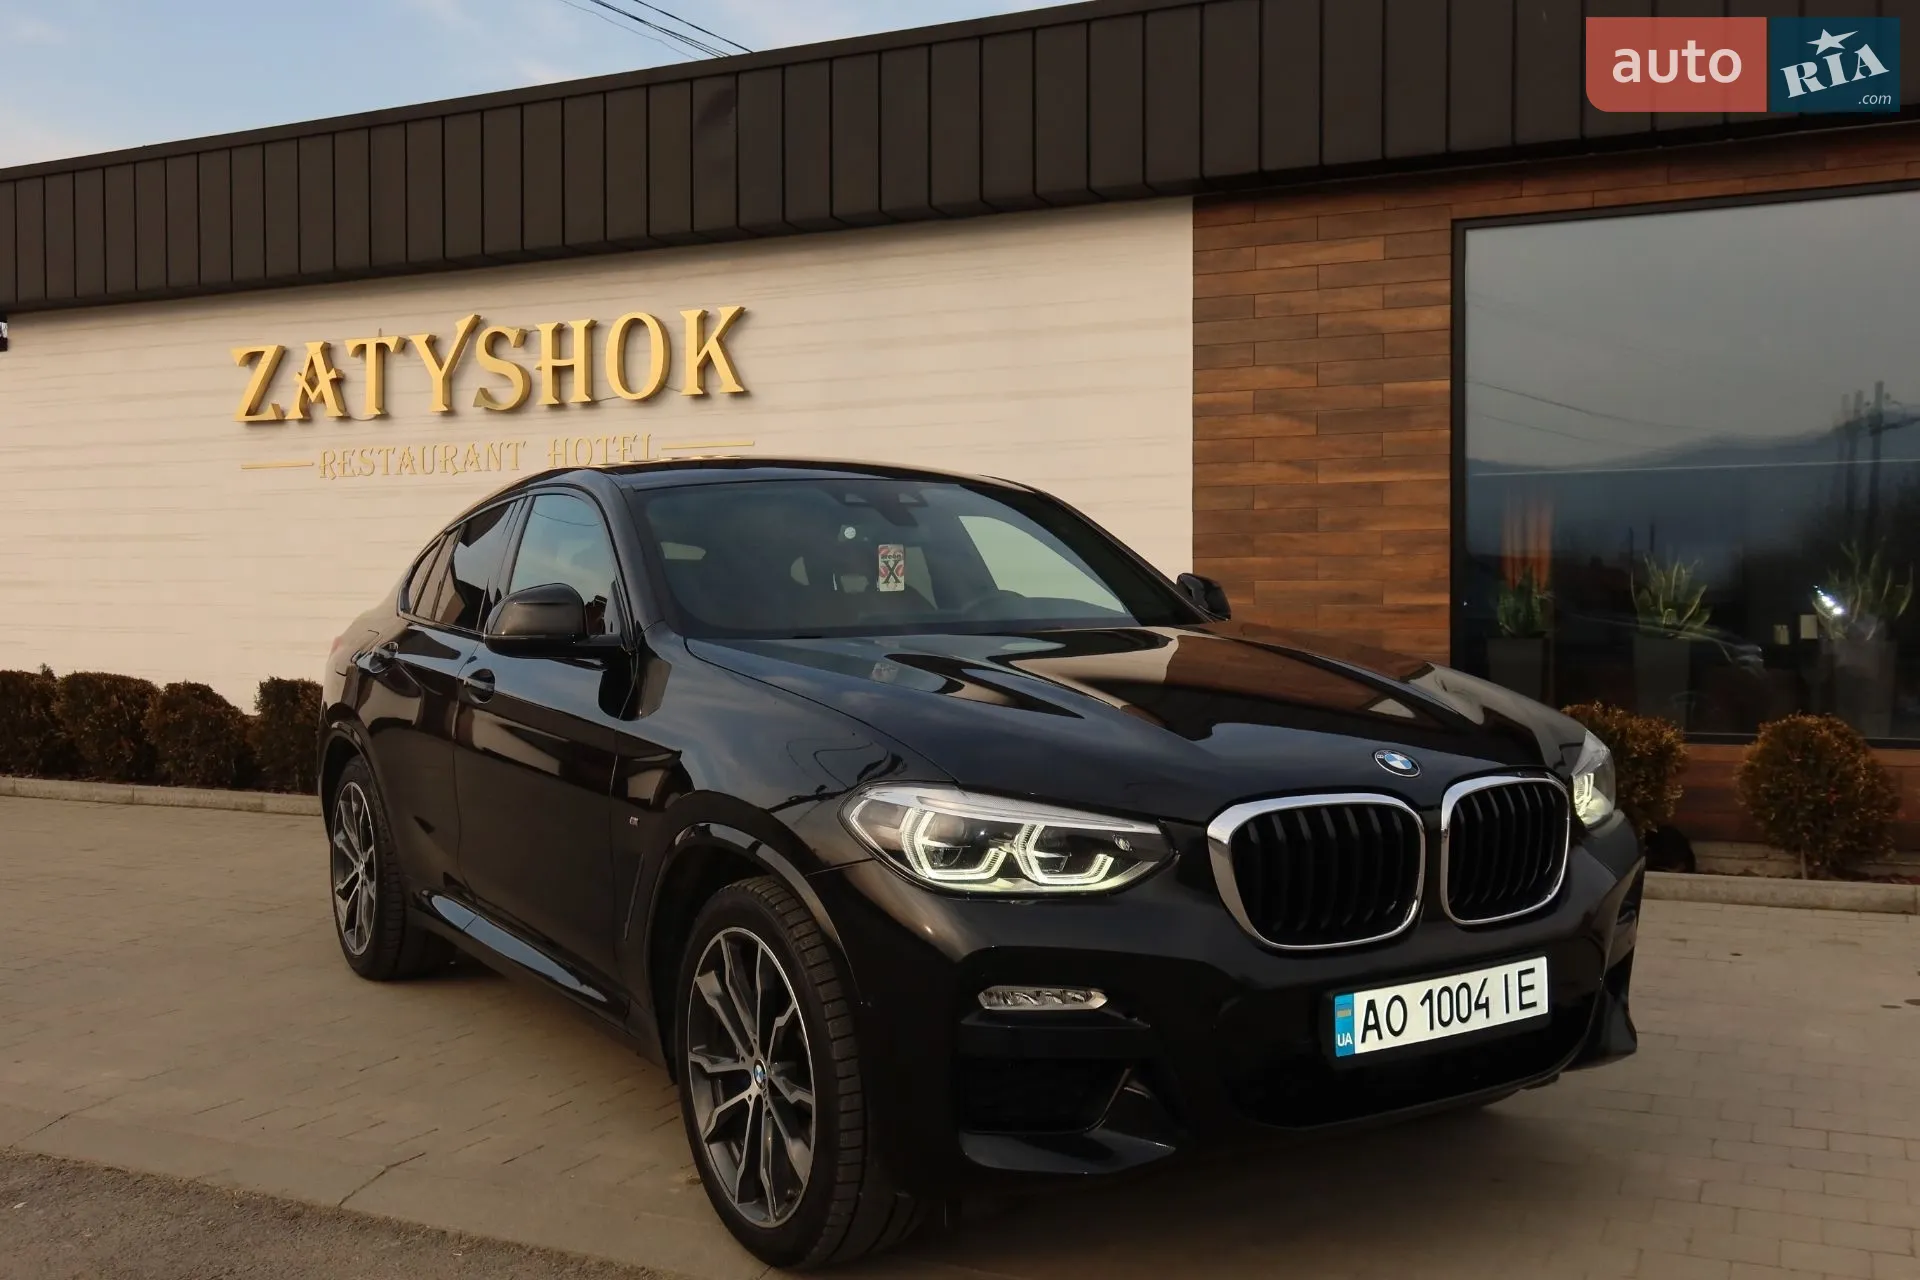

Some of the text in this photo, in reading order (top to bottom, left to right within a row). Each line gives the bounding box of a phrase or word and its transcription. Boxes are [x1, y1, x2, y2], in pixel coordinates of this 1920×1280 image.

[231, 305, 747, 424] ZATYSHOK
[319, 433, 660, 481] RESTAURANT HOTEL
[1360, 967, 1538, 1043] AO 1004 IE
[1337, 1032, 1353, 1047] UA
